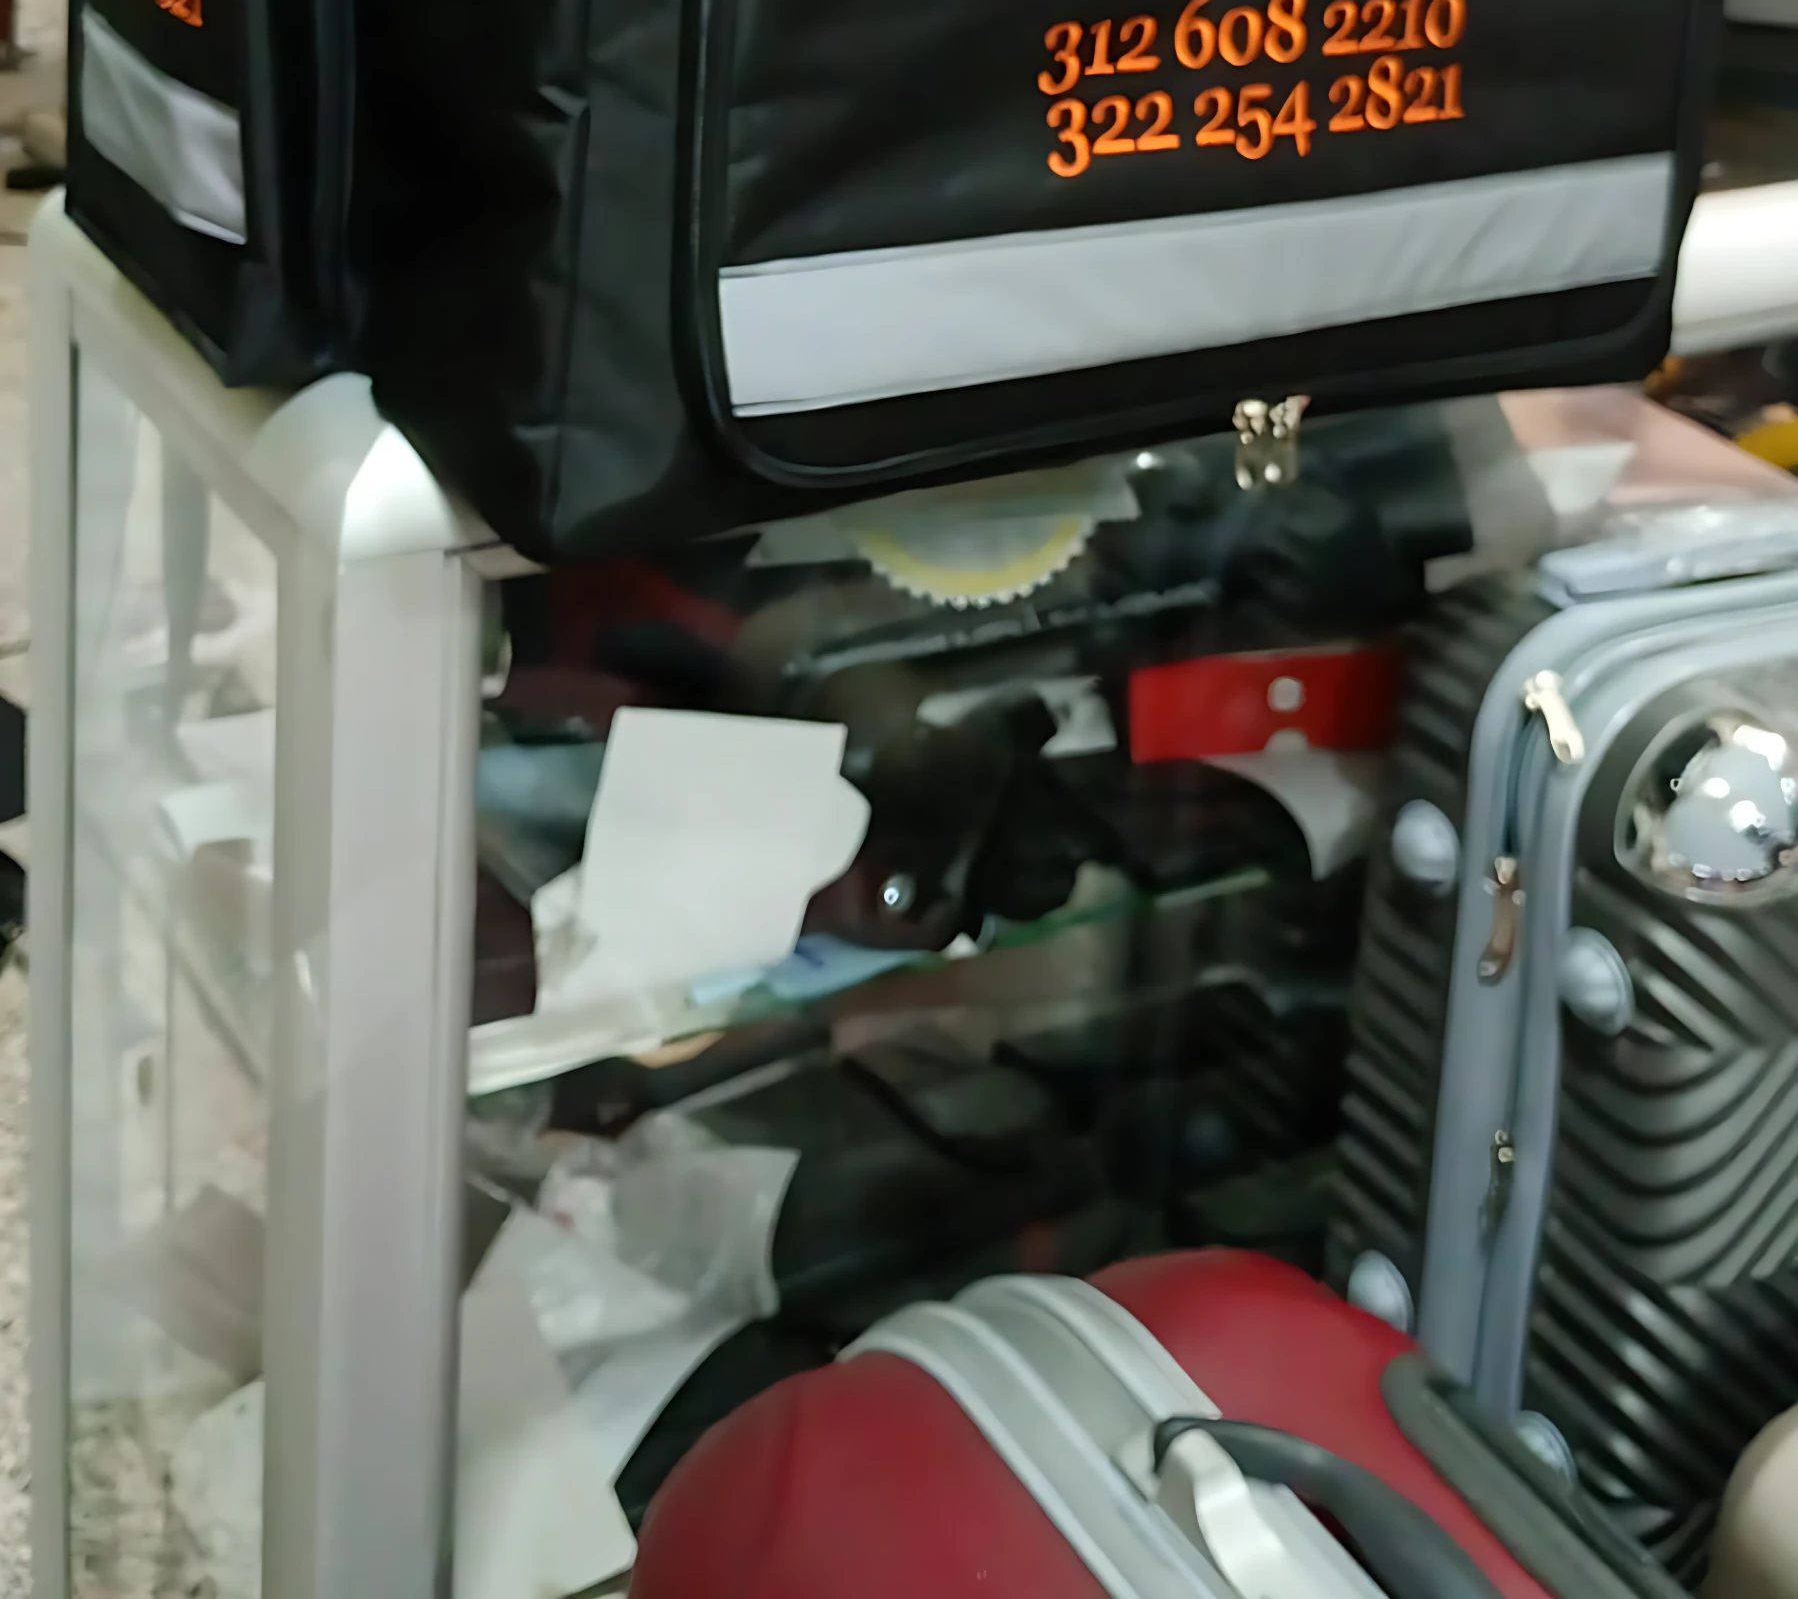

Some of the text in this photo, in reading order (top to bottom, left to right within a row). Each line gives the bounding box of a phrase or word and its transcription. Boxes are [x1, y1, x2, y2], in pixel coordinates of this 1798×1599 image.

[1038, 14, 1161, 96] 312
[1046, 55, 1466, 178] 322 254 2821
